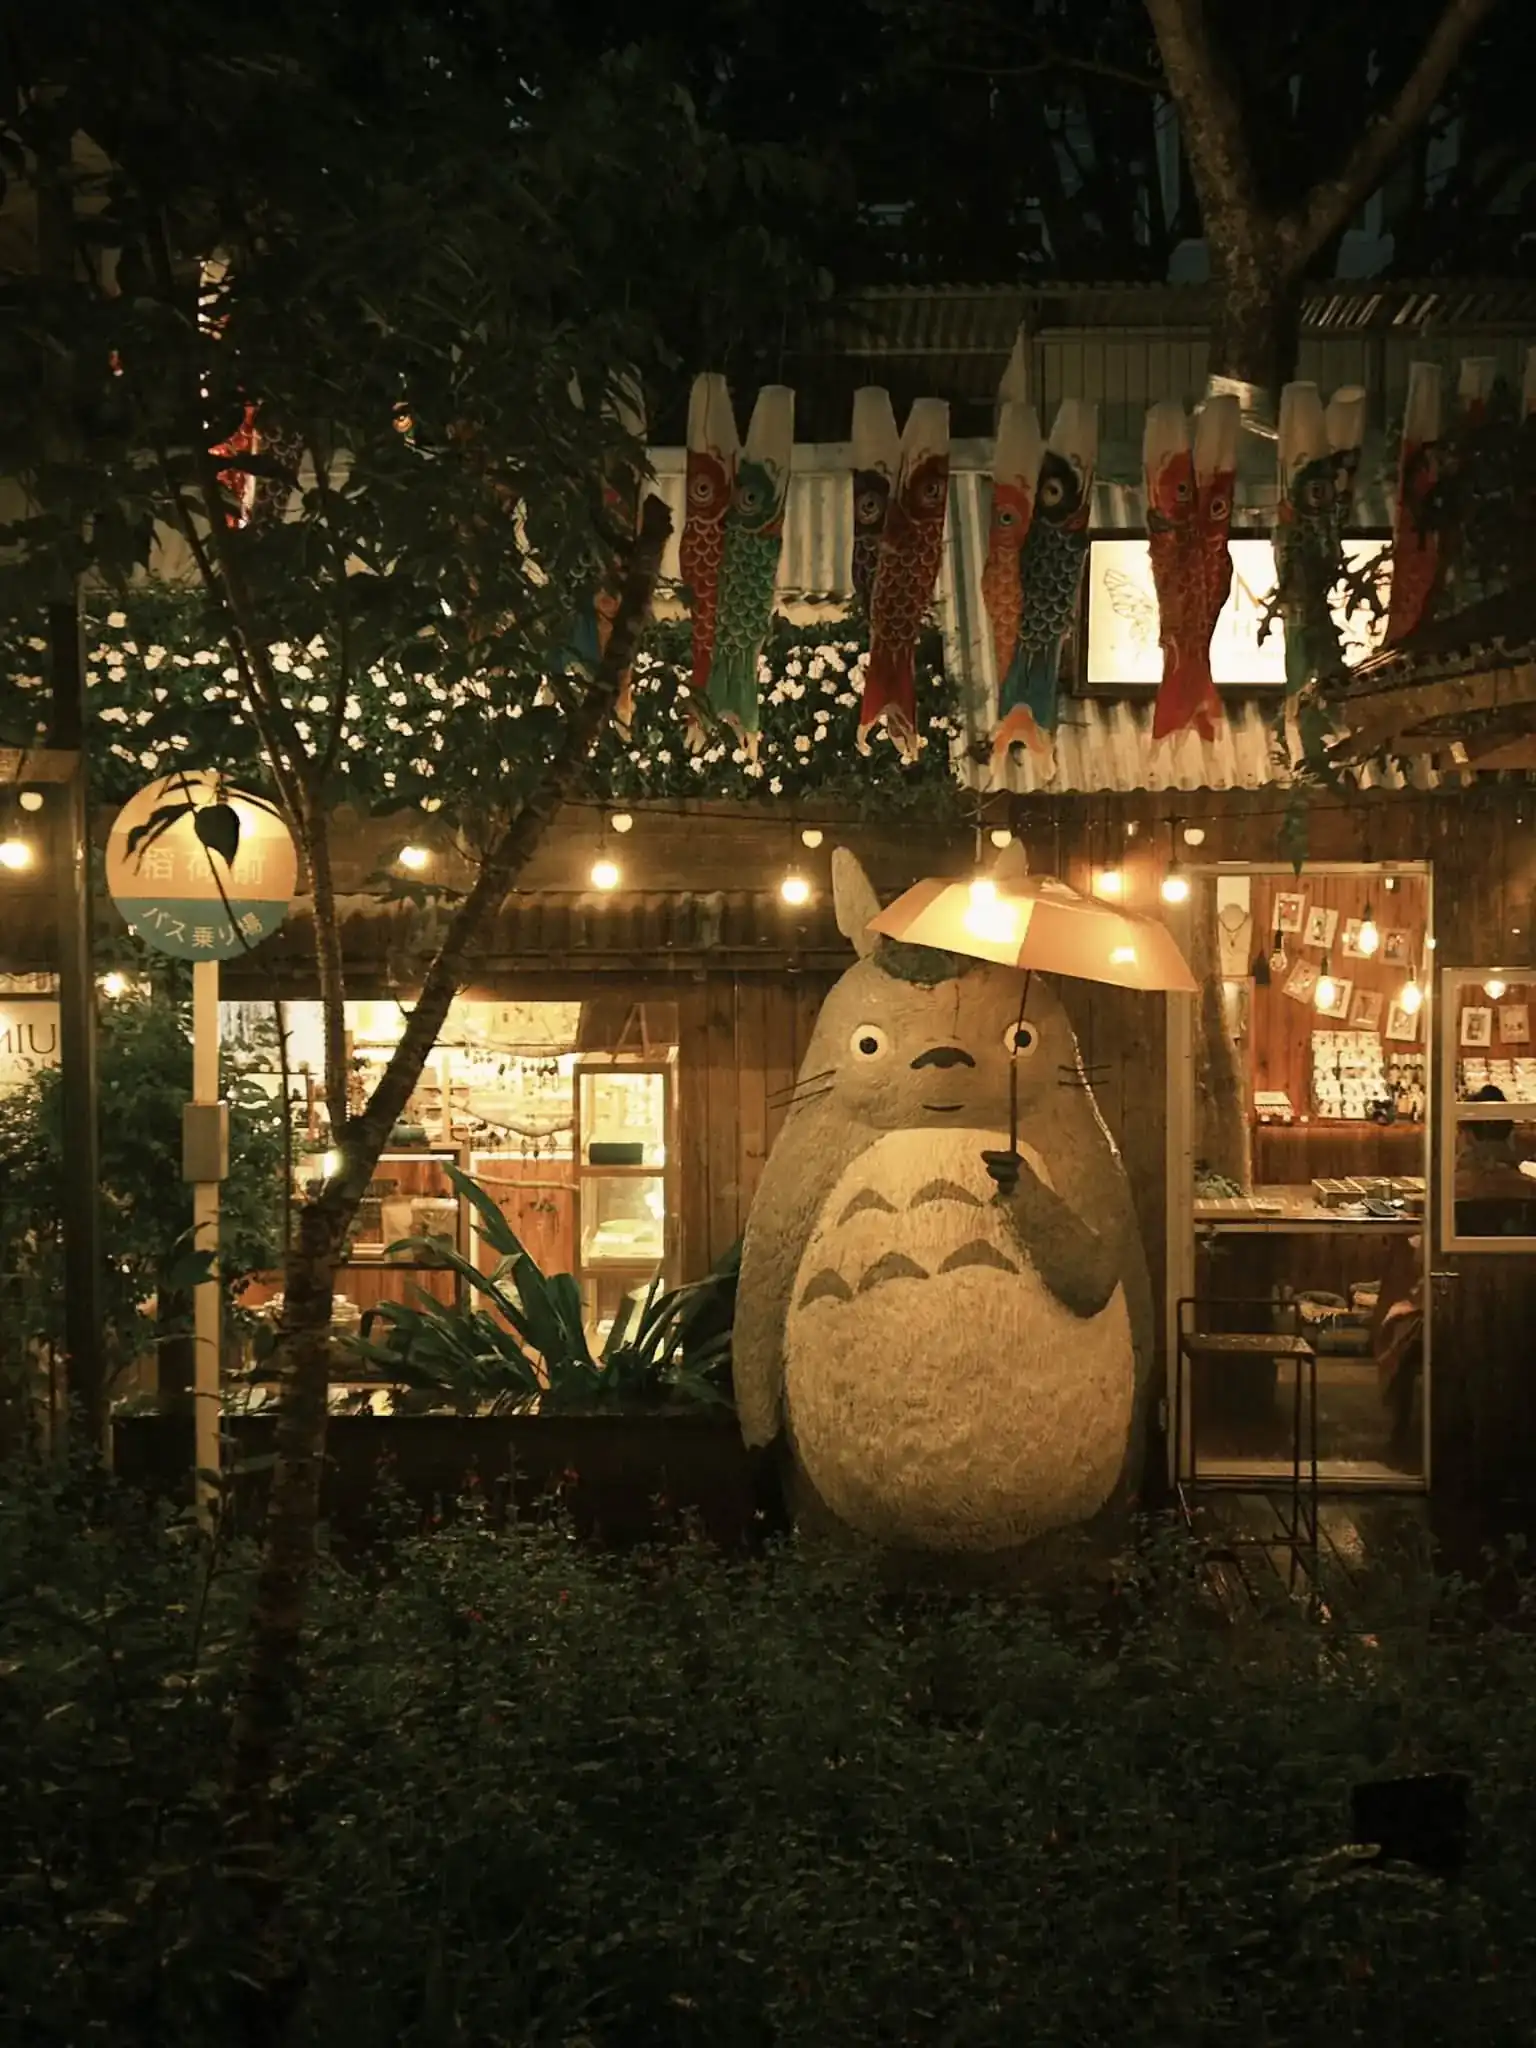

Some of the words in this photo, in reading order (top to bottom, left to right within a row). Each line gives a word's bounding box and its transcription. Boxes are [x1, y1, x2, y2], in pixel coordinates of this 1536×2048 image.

[141, 907, 263, 949] バス乗り場
